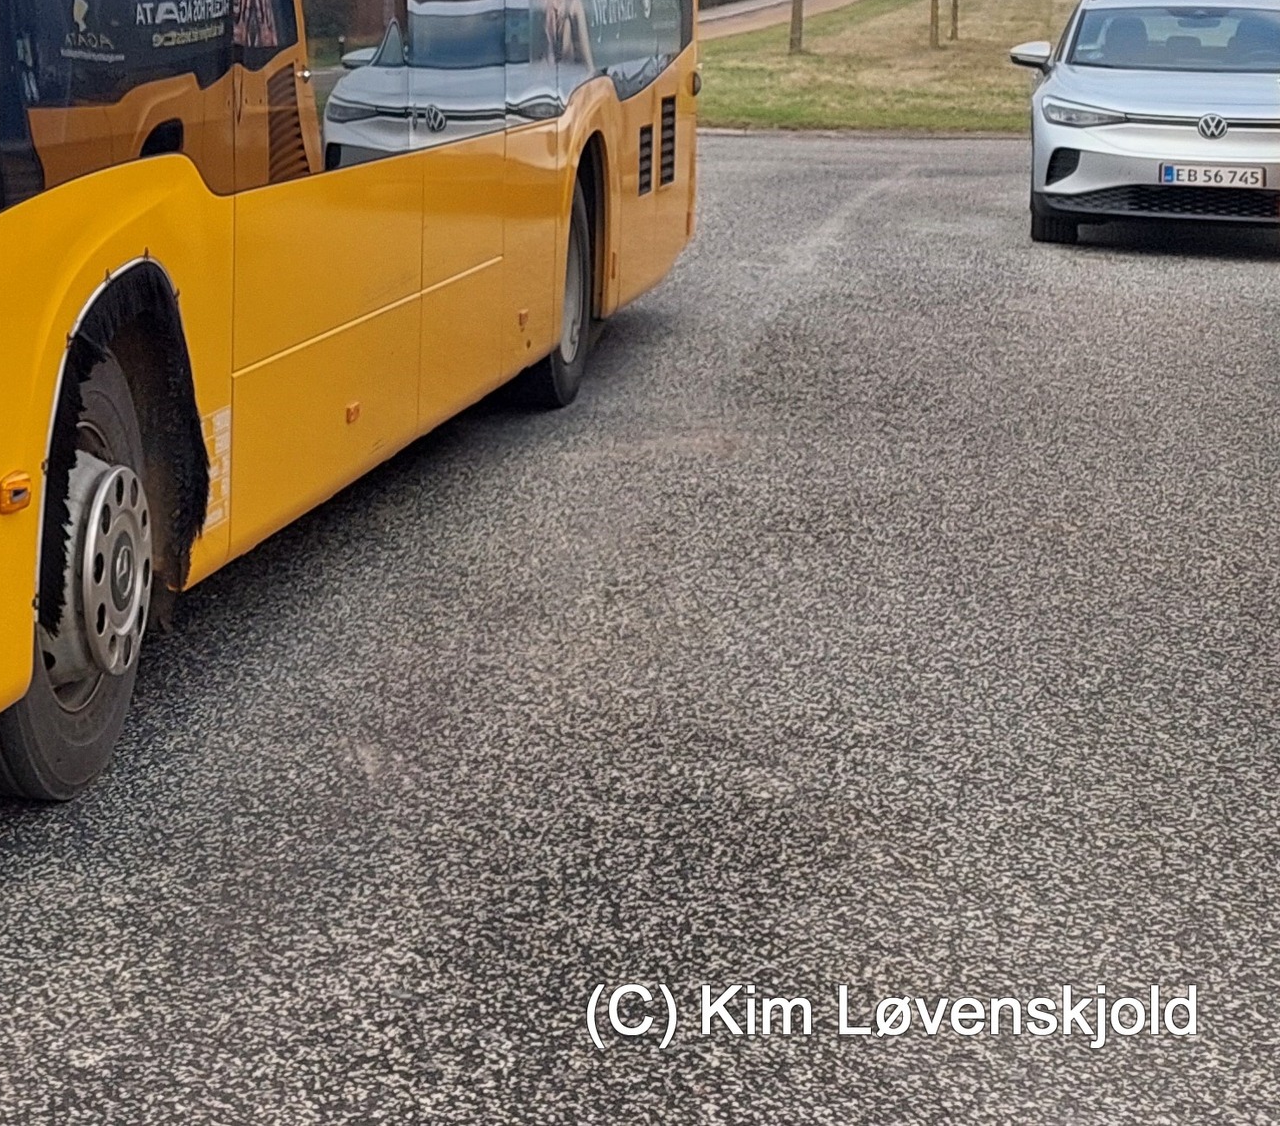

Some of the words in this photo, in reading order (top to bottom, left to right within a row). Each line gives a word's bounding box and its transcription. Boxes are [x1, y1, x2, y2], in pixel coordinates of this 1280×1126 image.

[1175, 168, 1198, 183] EB
[1202, 169, 1224, 184] 56
[1227, 170, 1260, 185] 745
